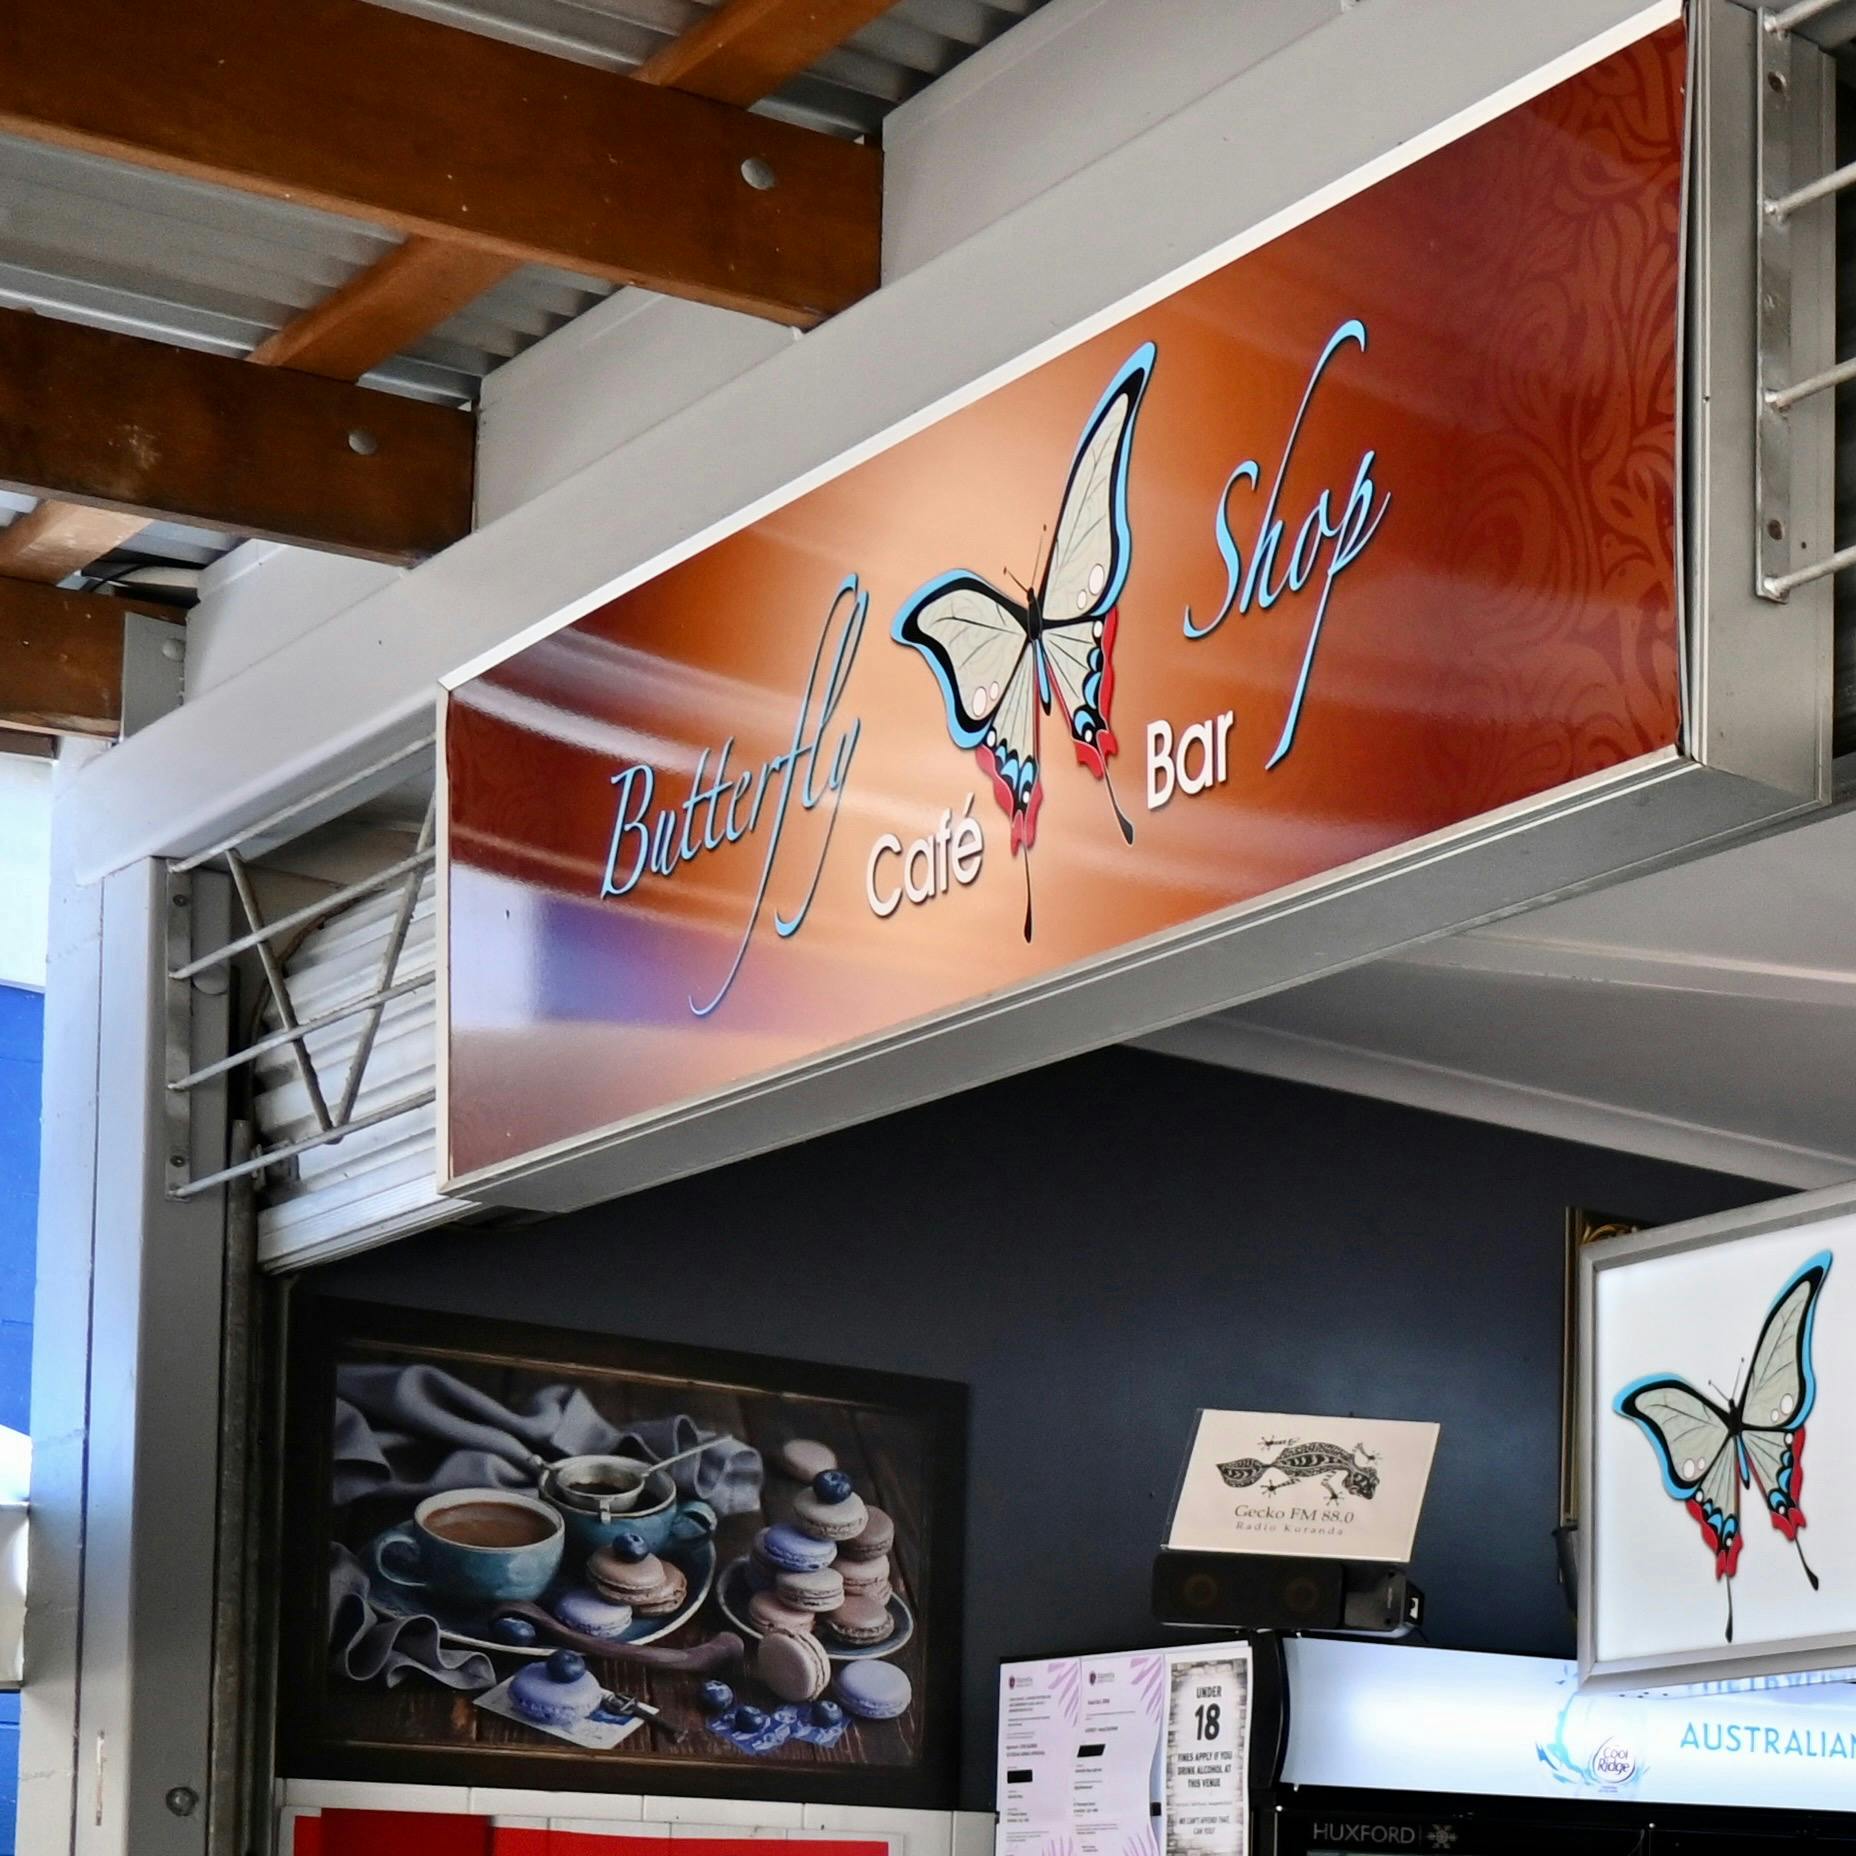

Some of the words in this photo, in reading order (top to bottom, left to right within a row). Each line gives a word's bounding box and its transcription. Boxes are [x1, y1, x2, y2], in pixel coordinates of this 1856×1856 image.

[600, 571, 868, 1017] Butterfly
[1183, 317, 1391, 771] Shop
[867, 790, 984, 919] Café
[1146, 707, 1236, 812] Bar
[1234, 1505, 1285, 1522] Gecko
[1291, 1507, 1316, 1522] FM
[1321, 1509, 1355, 1523] 88.0
[1236, 1522, 1277, 1534] Radio
[1284, 1524, 1344, 1536] Kuranda
[1196, 1686, 1221, 1699] UNDER
[1195, 1703, 1220, 1740] 18
[1603, 1747, 1628, 1759] Cool
[1597, 1758, 1630, 1774] Ridge
[1313, 1823, 1415, 1844] HUXFORD
